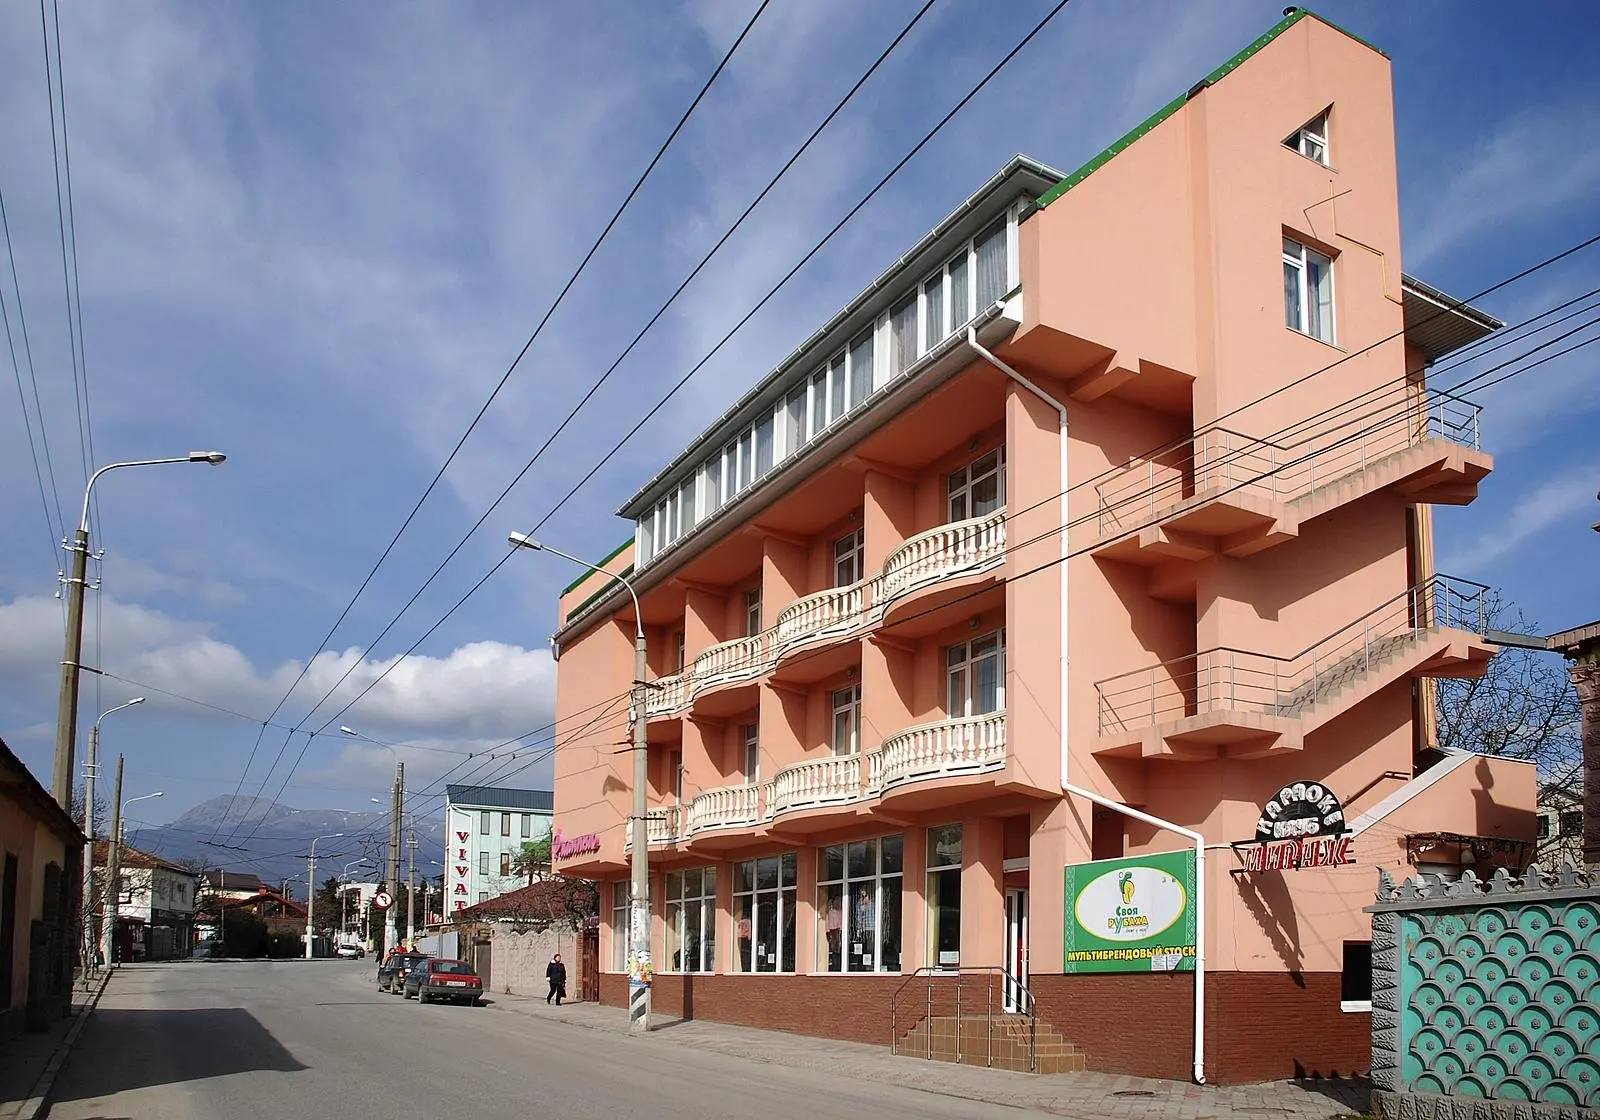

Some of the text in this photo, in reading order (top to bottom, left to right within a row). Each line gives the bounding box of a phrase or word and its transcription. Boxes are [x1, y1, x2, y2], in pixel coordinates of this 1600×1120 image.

[1257, 783, 1343, 834] КАРАОКЕ
[455, 831, 470, 911] VIVAT
[1244, 837, 1351, 871] МИРАЖ
[1067, 945, 1196, 961] МУЛЬТИБРЕНДОВЫЙ STOCK
